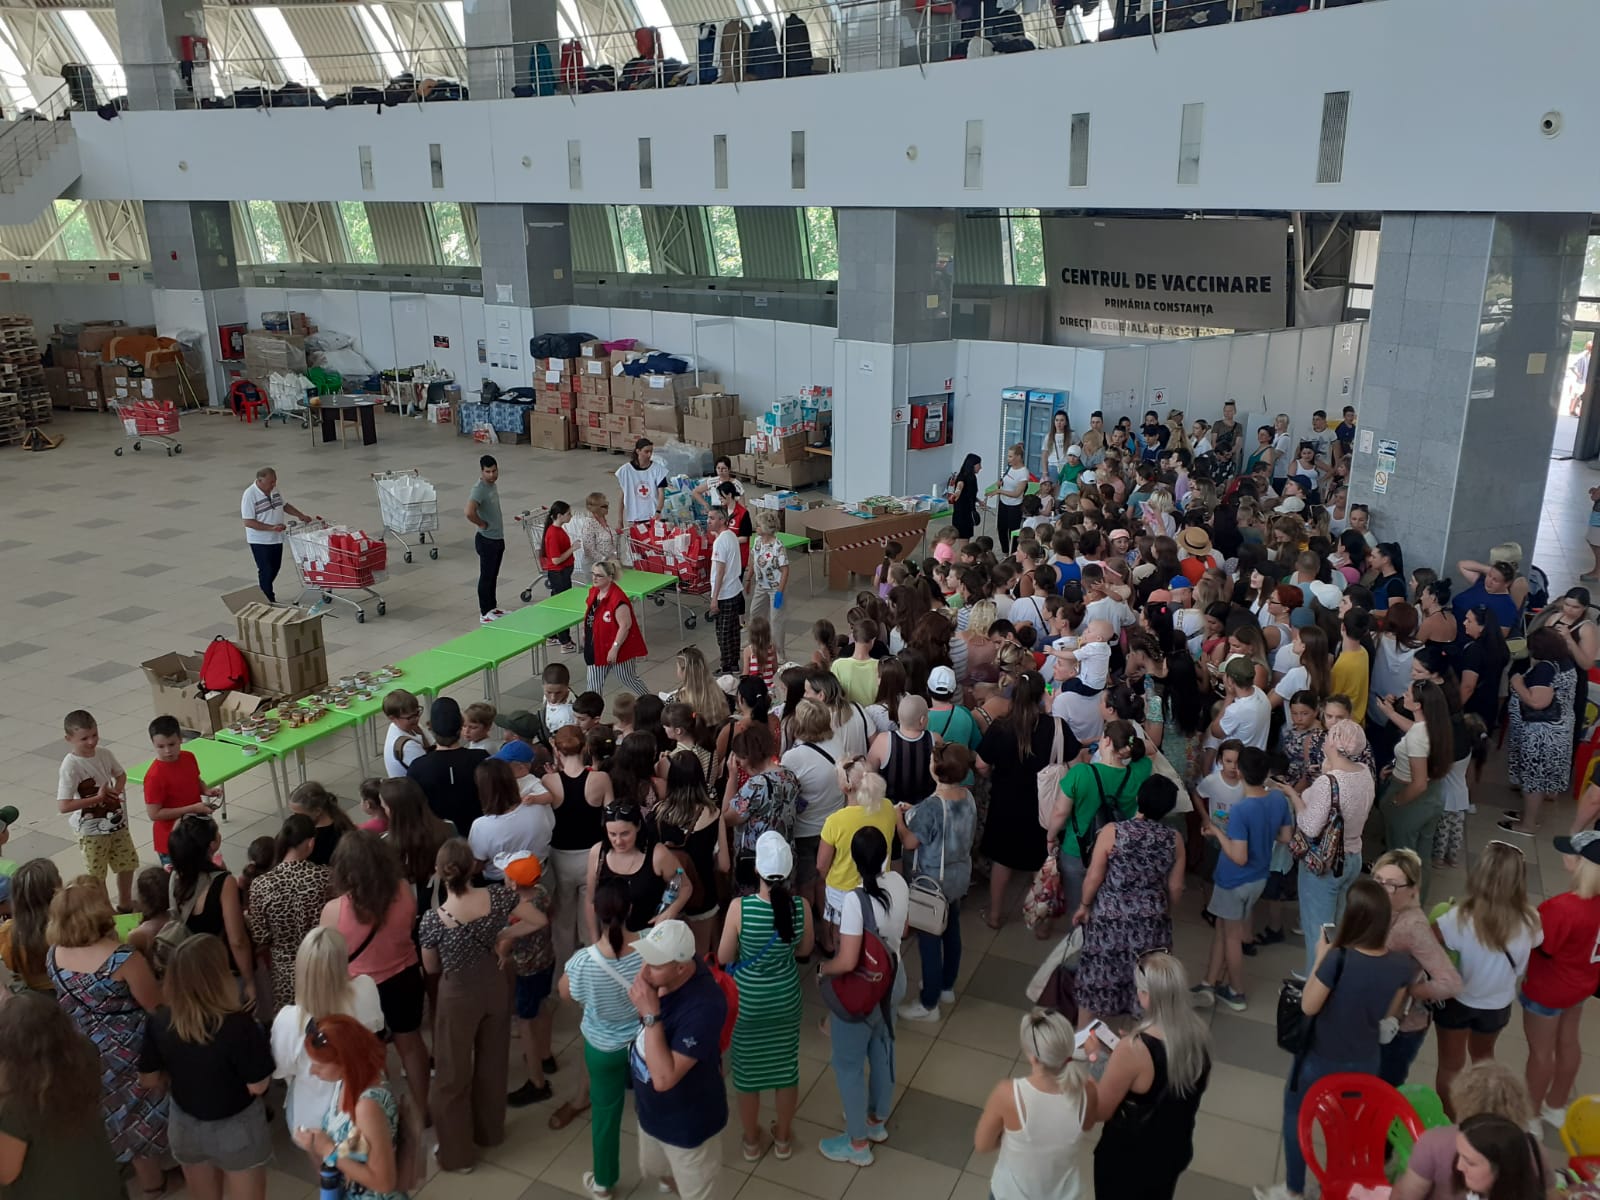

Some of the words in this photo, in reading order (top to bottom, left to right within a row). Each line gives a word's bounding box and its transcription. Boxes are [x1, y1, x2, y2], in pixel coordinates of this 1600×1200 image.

[1061, 267, 1130, 288] CENTRUL
[1135, 273, 1157, 290] DE
[1161, 274, 1272, 293] VACCINARE
